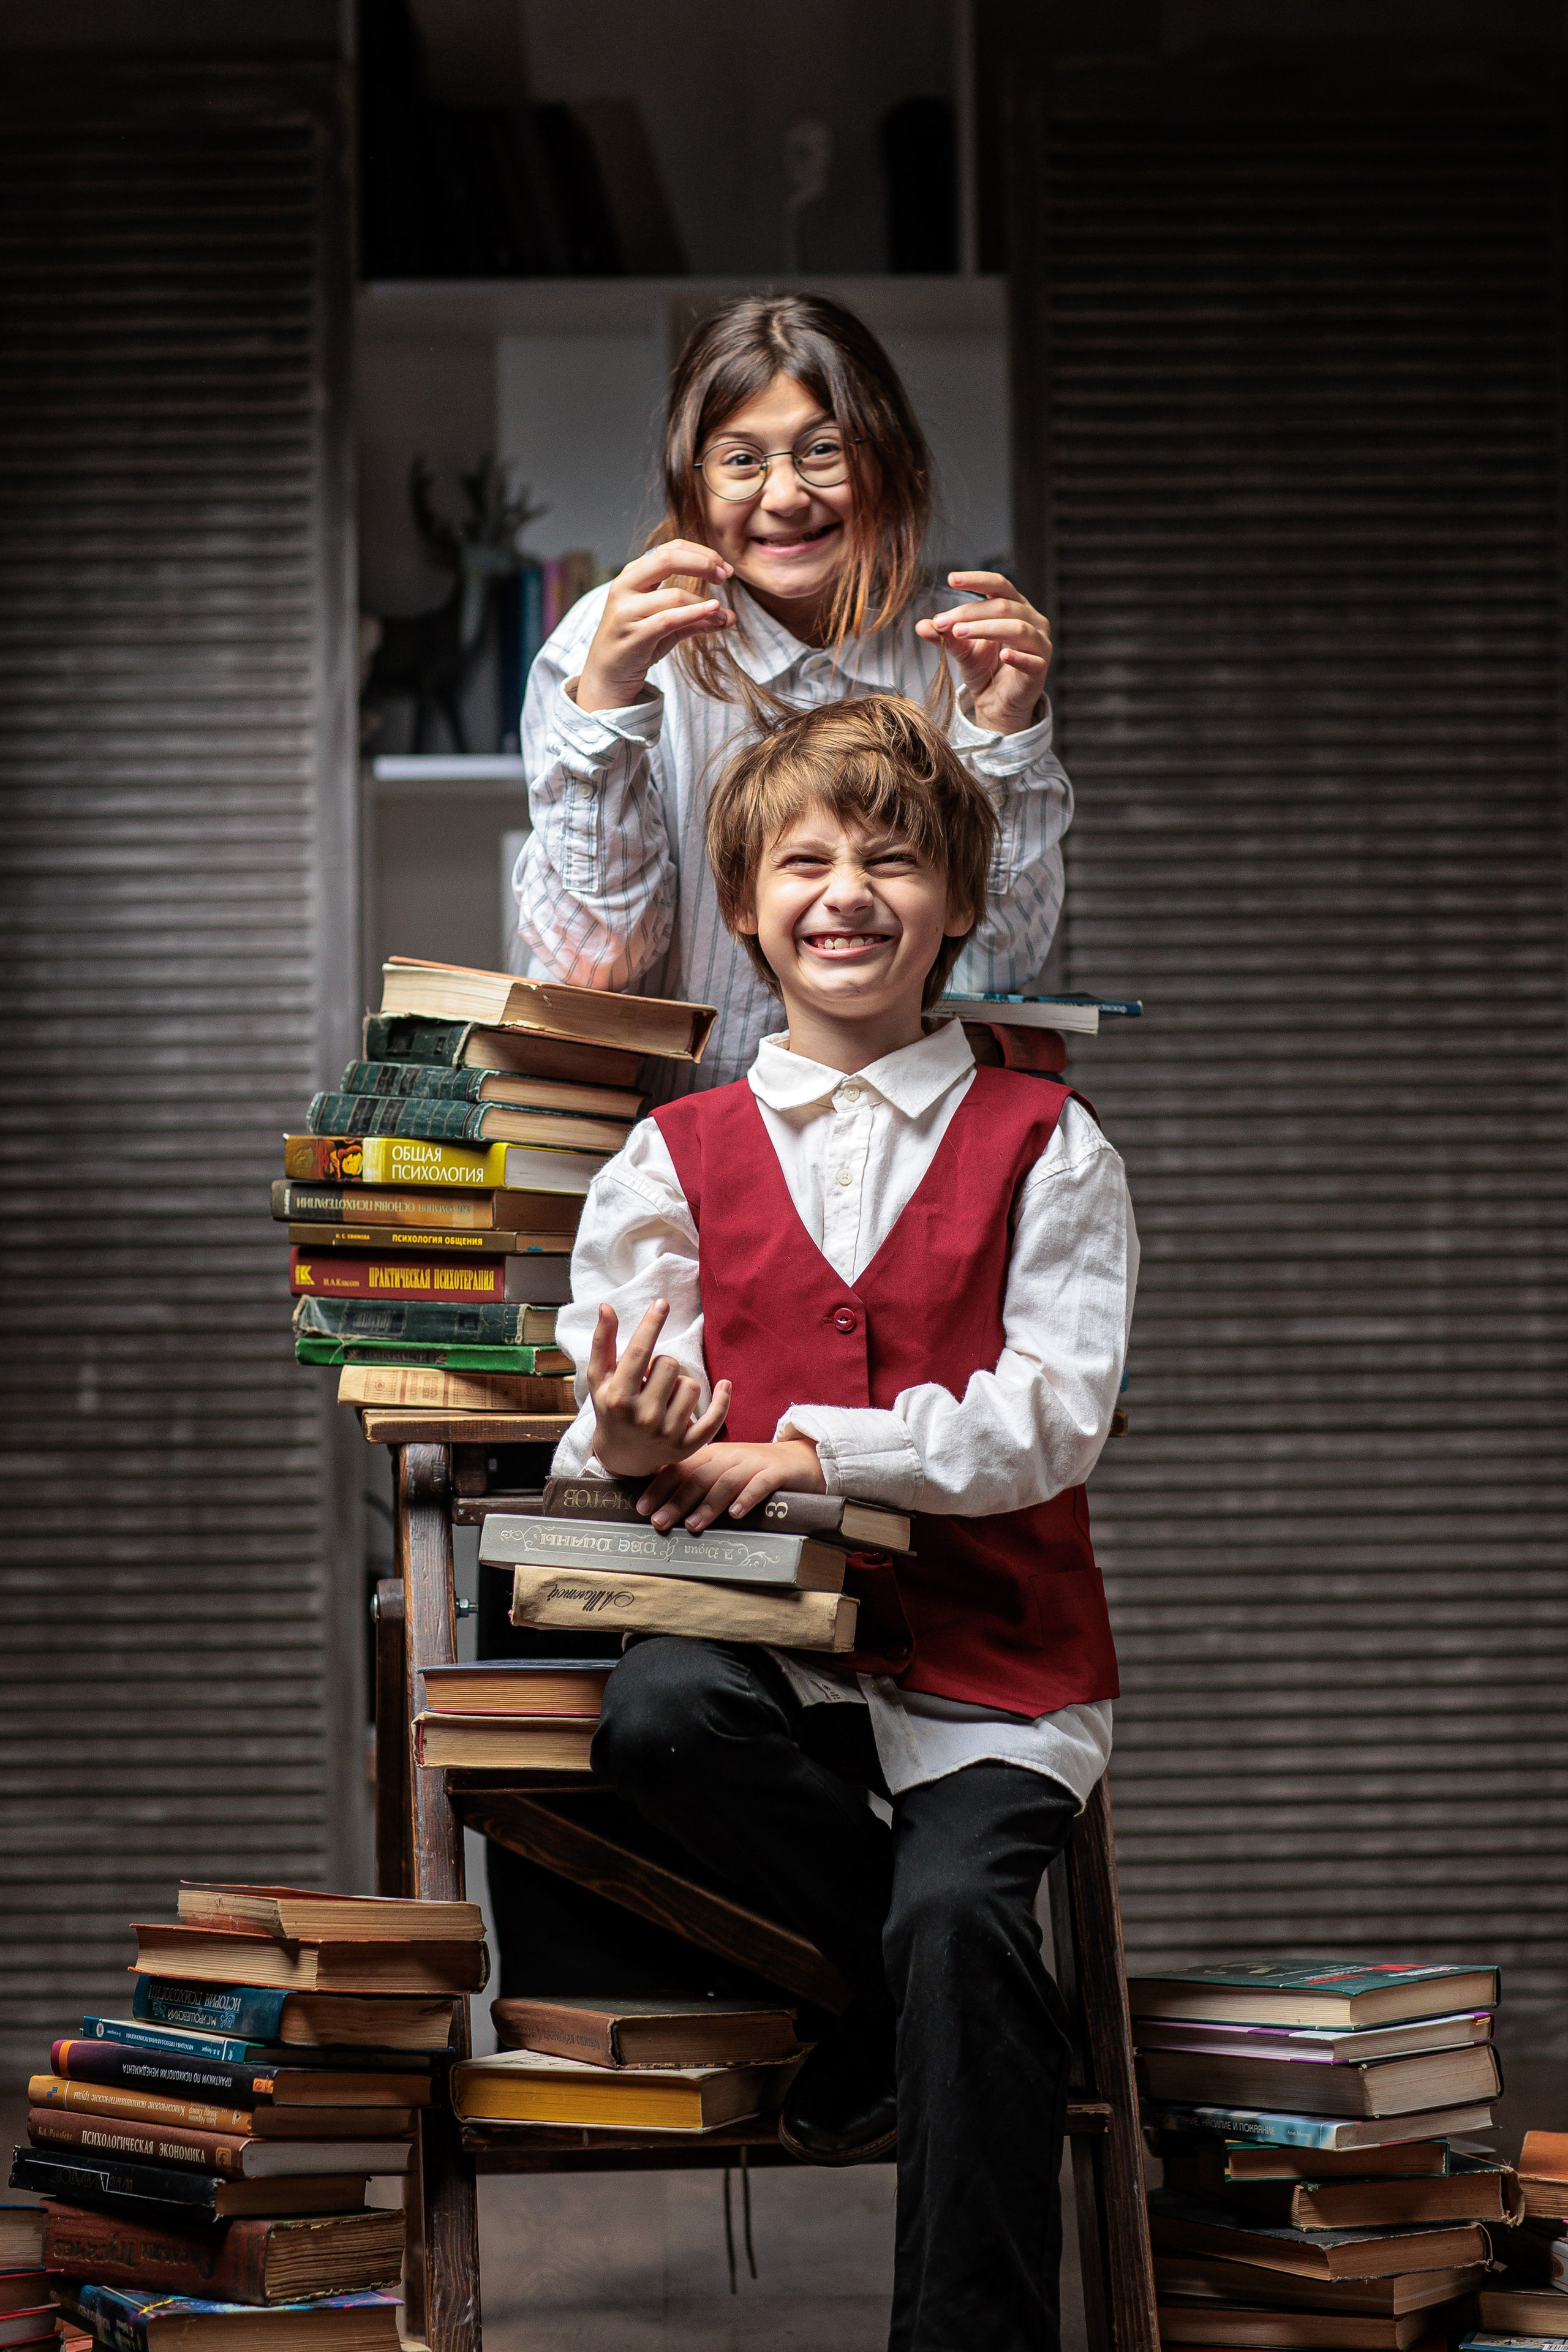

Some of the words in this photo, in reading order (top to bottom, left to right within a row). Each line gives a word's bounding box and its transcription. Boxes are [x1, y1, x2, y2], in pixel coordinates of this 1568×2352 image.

[391, 1144, 442, 1164] ОБЩАЯ
[391, 1164, 484, 1183] ПСИХОЛОГИЯ
[296, 1196, 373, 1212] ПСИХОТЕРАПИИ
[374, 1200, 415, 1213] ОСНОВЫ
[392, 1234, 443, 1245] ПСИХОЛОГИЯ
[445, 1236, 483, 1247] ОБЩЕНИЯ
[368, 1267, 431, 1289] ПРАКТИЧЕСКАЯ
[434, 1268, 495, 1291] ПСИХОТЕРАПИЯ
[563, 1489, 636, 1511] ЧЕТОВ
[148, 1985, 203, 2005] ПСИХОЛОГИИ
[204, 1993, 242, 2013] ИСТОРИЯ
[126, 2032, 149, 2043] ПСИХОЛОГИИ
[149, 2037, 176, 2048] ПРЕПОДАВАНИЯ
[175, 2041, 194, 2051] МЕТОДИКА
[123, 2064, 159, 2078] МЕНЕДЖМЕНТА
[160, 2068, 193, 2083] ПСИХОЛОГИИ
[193, 2073, 201, 2083] ПО
[202, 2075, 232, 2087] ПРАКТИКУМ
[74, 2090, 90, 2102] труды
[91, 2093, 147, 2109] психоаналитические
[148, 2100, 186, 2117] Классические
[1232, 2122, 1238, 2132] И
[1238, 2122, 1275, 2136] ПОКАЯНИЕ
[81, 2130, 154, 2155] ПСИХОЛОГИЧЕСКАЯ
[159, 2142, 205, 2164] ЭКОНОМИКА
